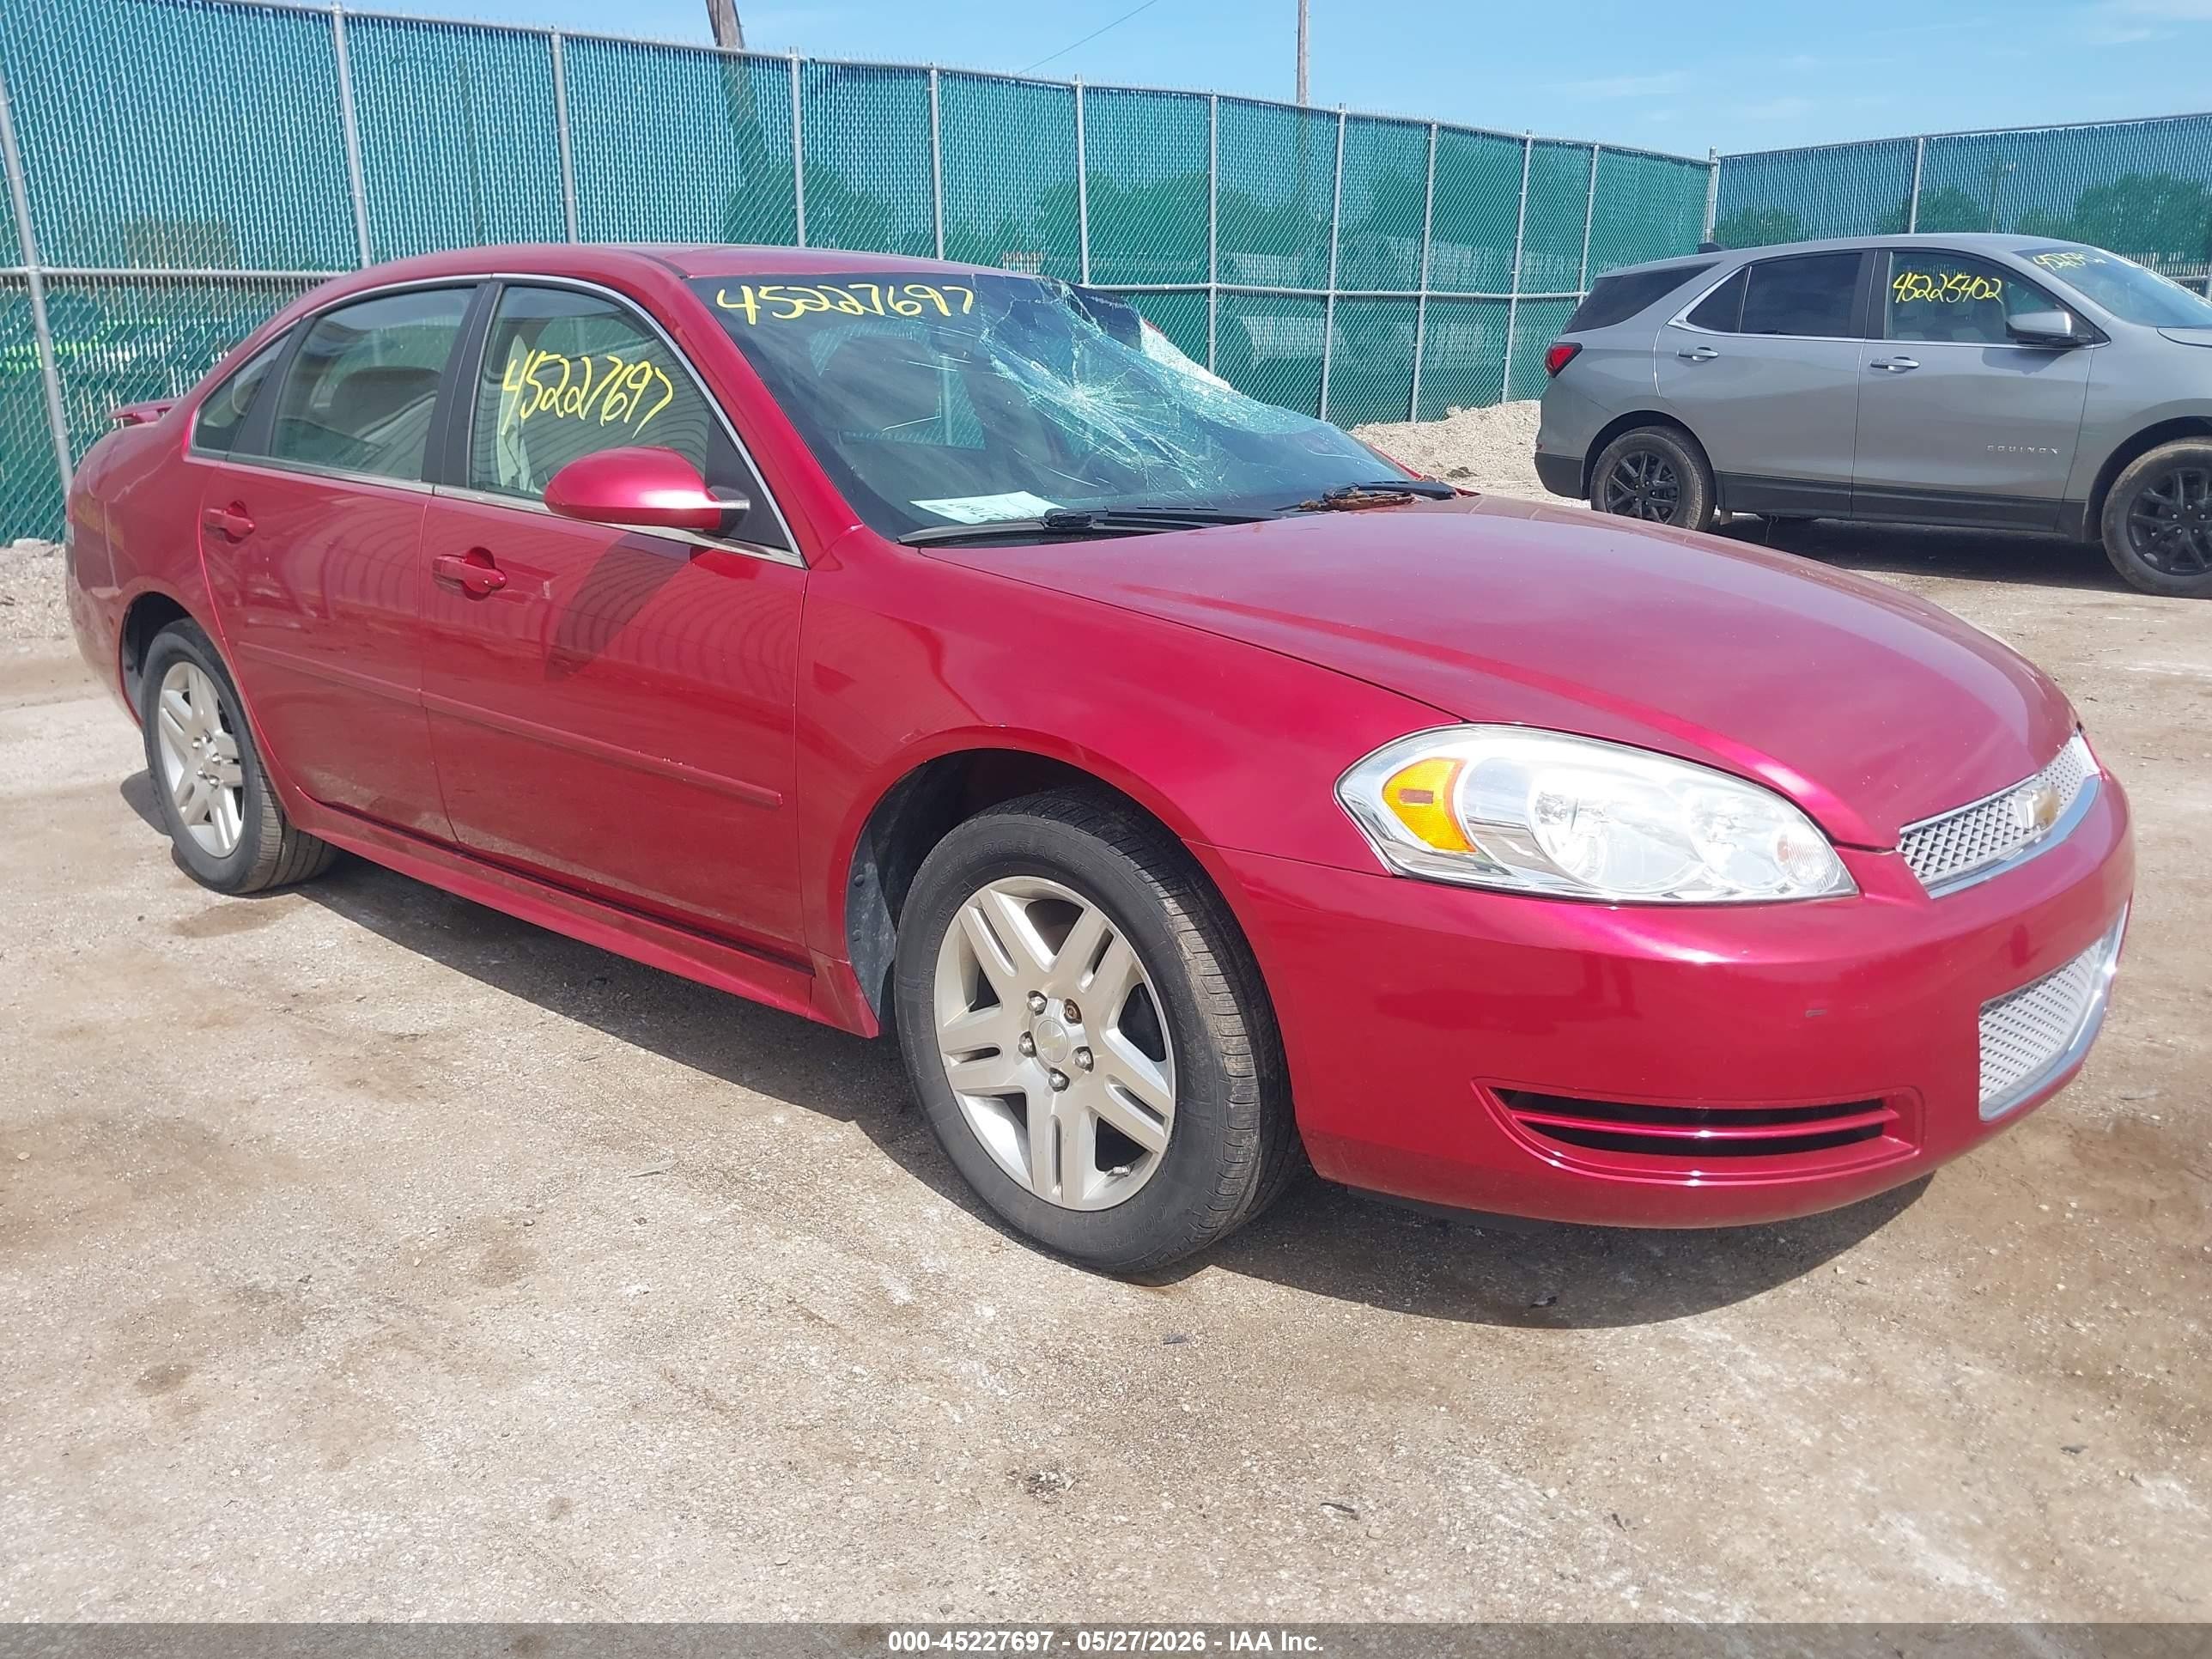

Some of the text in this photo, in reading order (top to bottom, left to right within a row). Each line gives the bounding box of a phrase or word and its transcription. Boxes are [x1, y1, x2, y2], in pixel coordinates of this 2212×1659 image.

[716, 283, 974, 325] 45227697
[1893, 271, 2003, 303] 45225402
[501, 349, 673, 440] 45227697
[1986, 445, 2058, 454] EQUINOX
